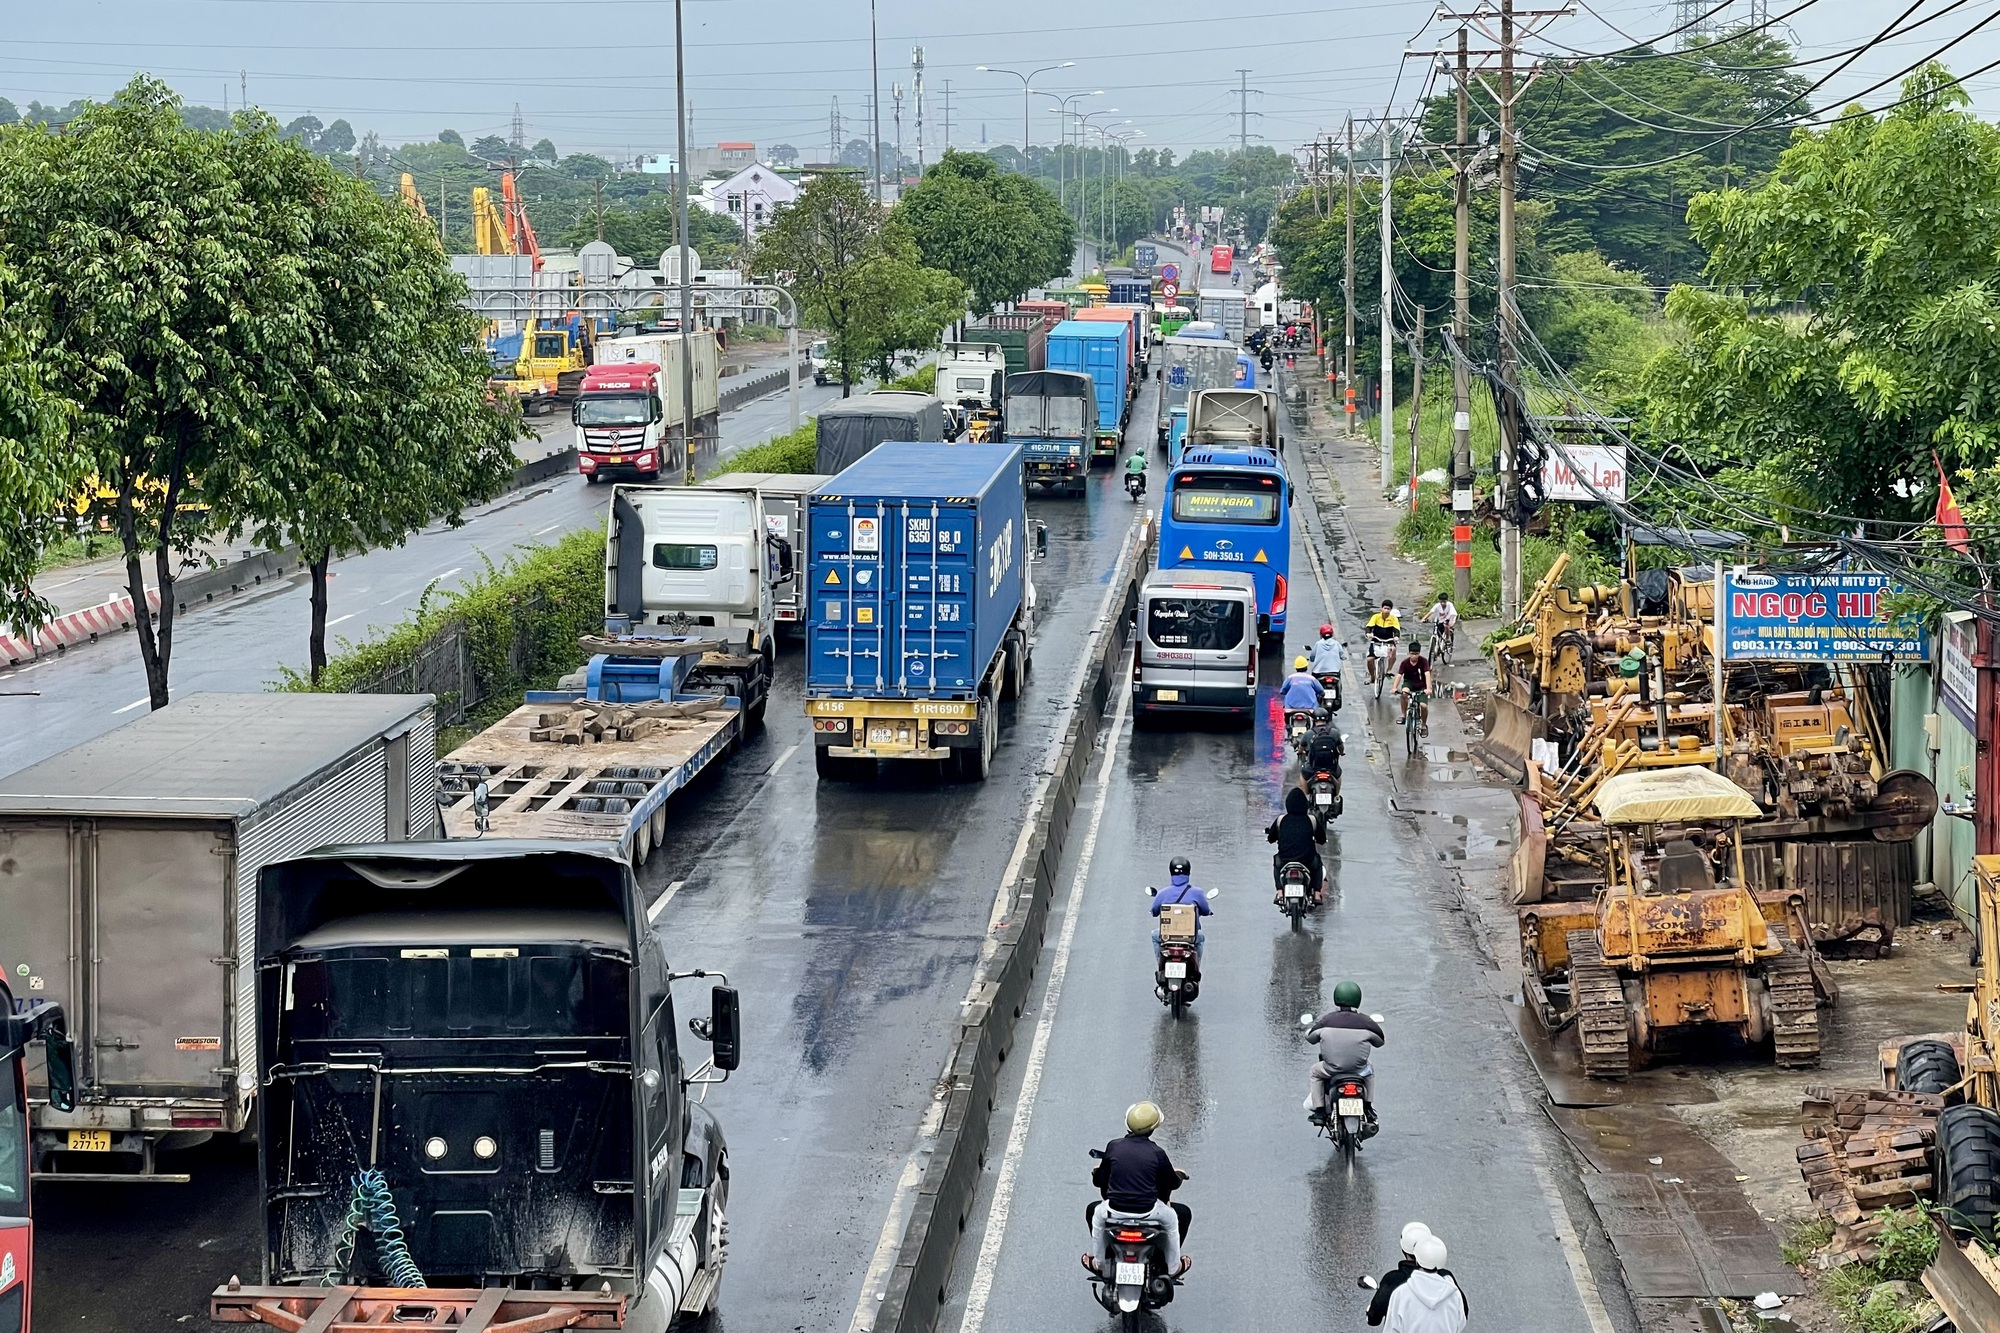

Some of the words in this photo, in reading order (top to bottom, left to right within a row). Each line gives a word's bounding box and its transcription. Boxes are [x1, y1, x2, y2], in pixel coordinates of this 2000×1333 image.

[1593, 462, 1621, 488] Lan
[1190, 496, 1219, 505] MINH
[908, 519, 931, 531] SKHU
[908, 531, 931, 543] 6350
[939, 531, 950, 543] 68
[823, 553, 878, 561] www.sinkor.co.kr
[1203, 551, 1244, 561] 50H-350.51
[1842, 576, 1866, 587] MTV
[1733, 592, 1827, 623] NGỌC
[1732, 640, 1819, 651] 0903.175.301
[1833, 640, 1921, 651] 0903.675.301
[817, 701, 845, 712] 4156
[913, 704, 967, 715] 51R16907
[80, 1130, 98, 1140] 61C
[72, 1140, 106, 1150] 277.17
